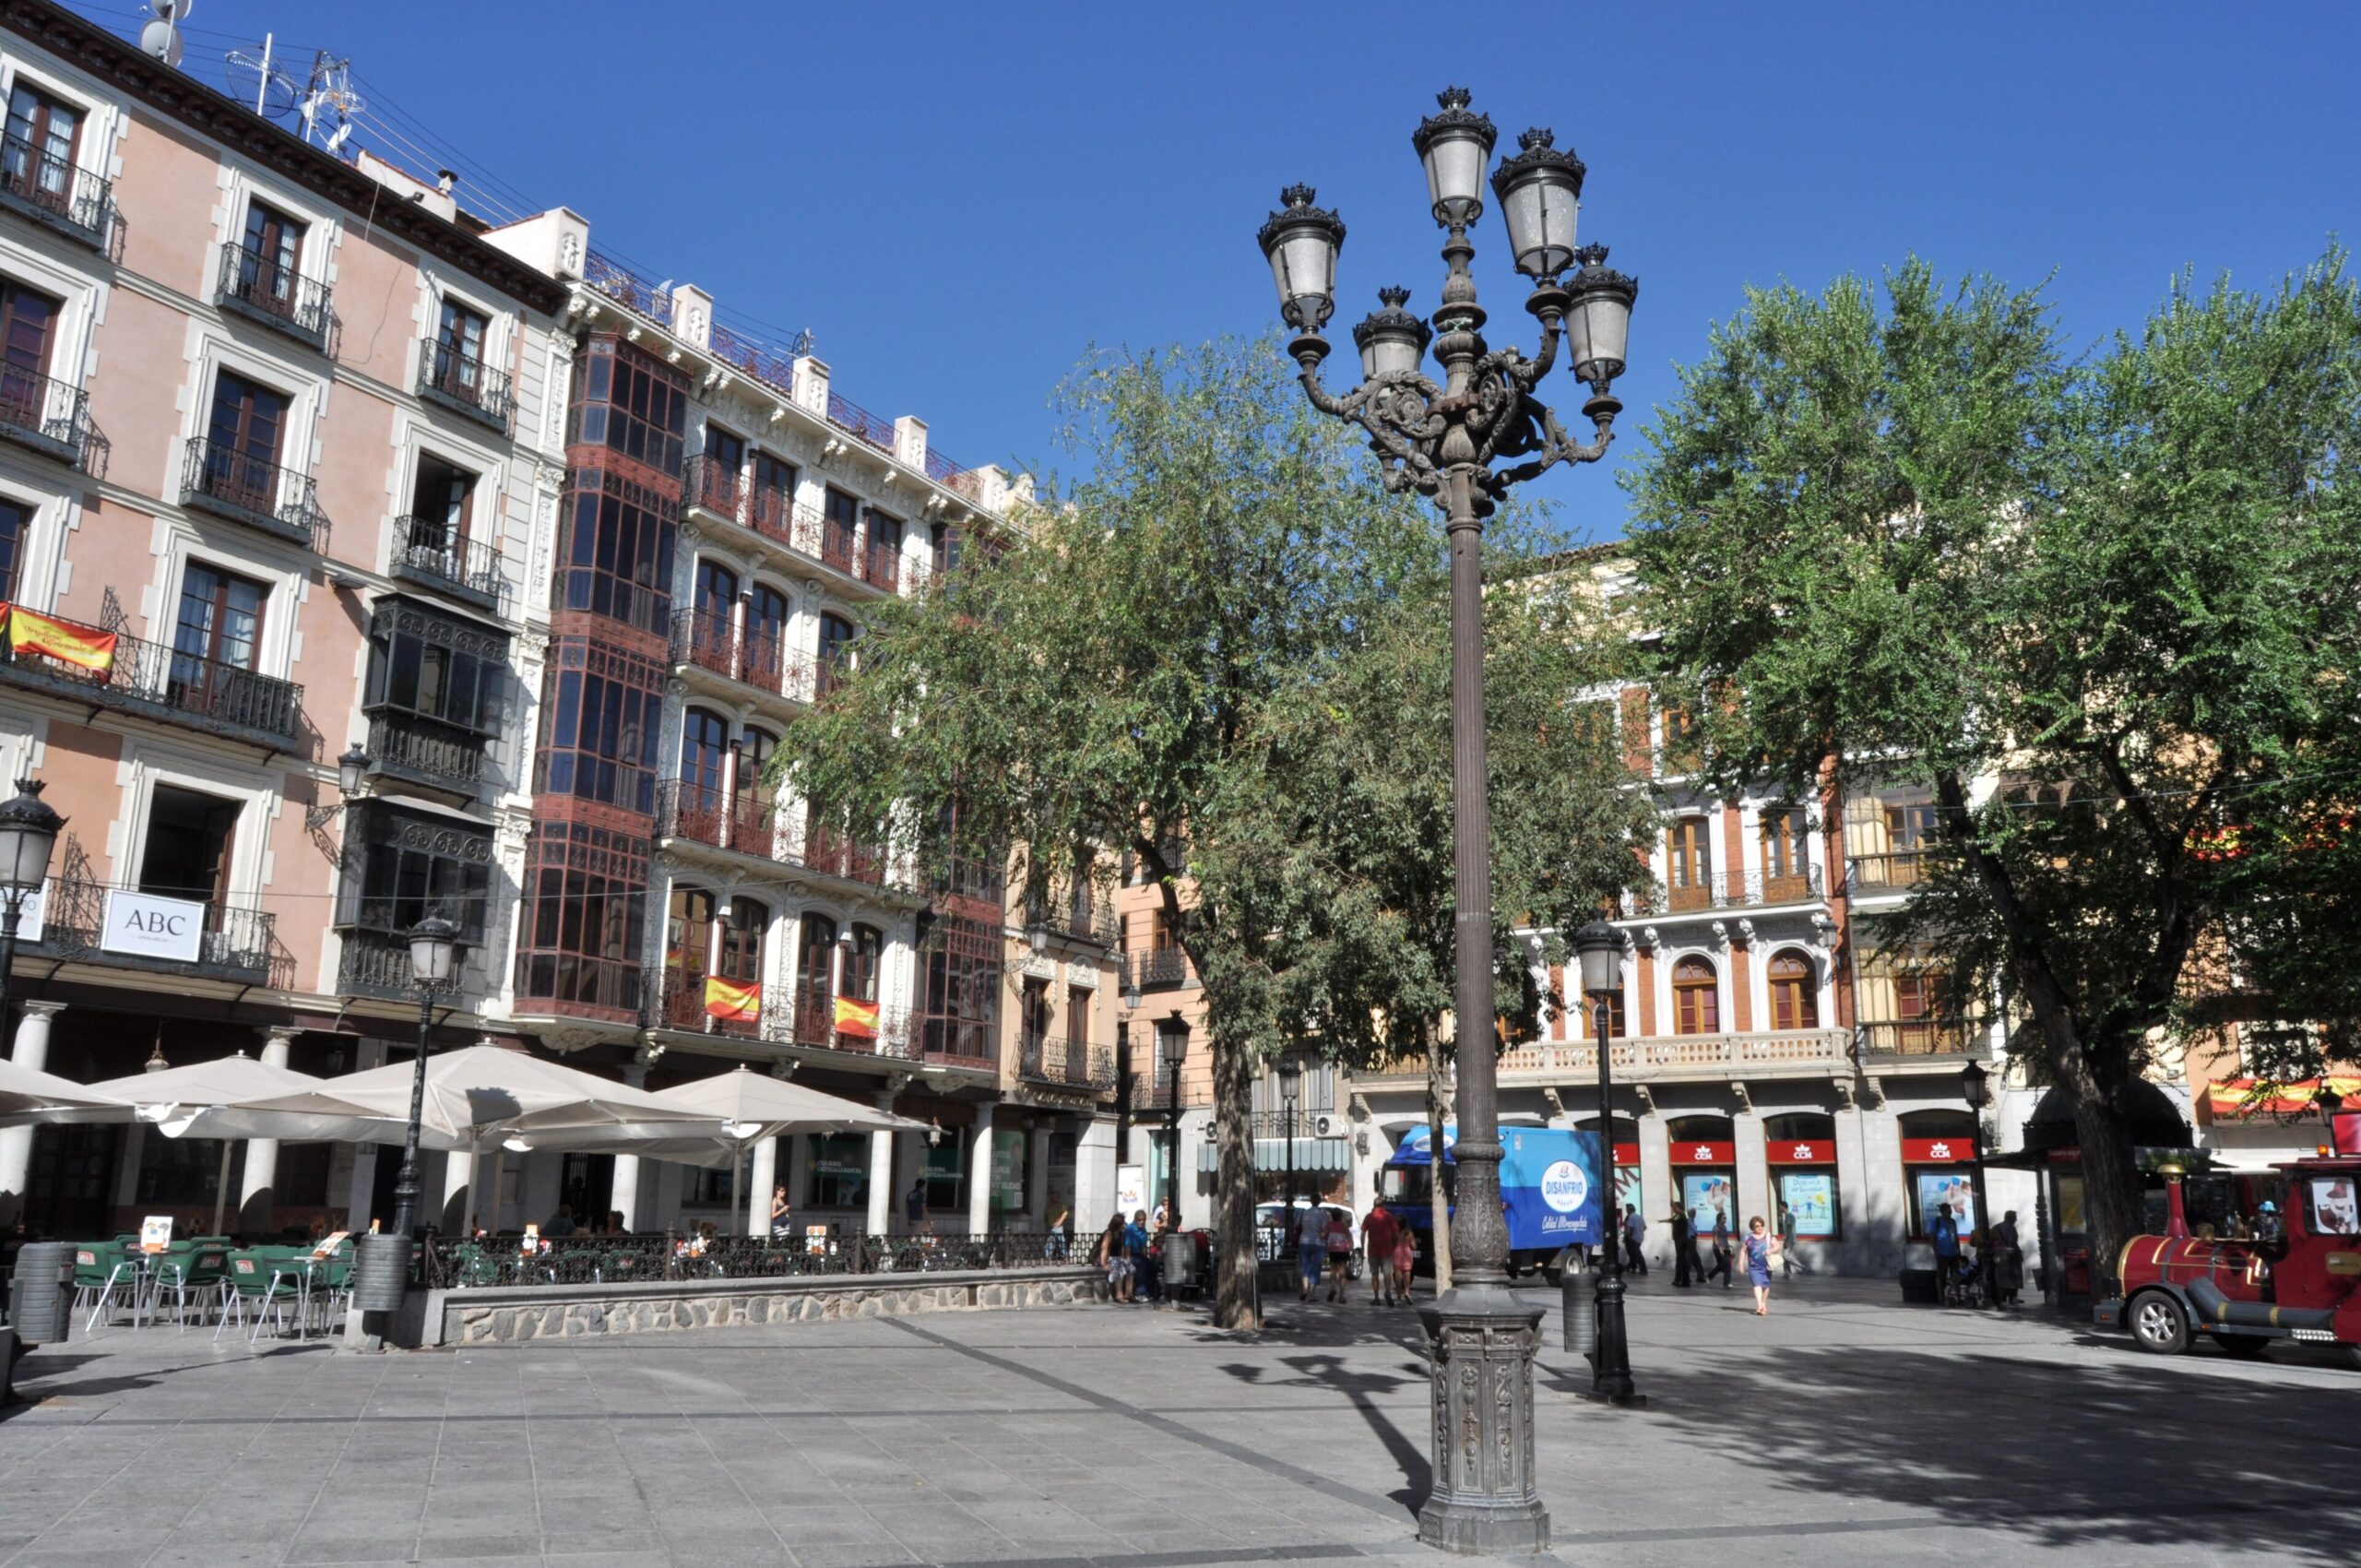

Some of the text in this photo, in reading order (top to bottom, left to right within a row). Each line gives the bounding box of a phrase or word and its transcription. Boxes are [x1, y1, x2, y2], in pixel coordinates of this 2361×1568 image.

[125, 909, 186, 936] ABC
[1695, 1152, 1713, 1160] CCM
[1793, 1151, 1812, 1159] CCM
[1930, 1150, 1951, 1158] CCM
[1546, 1181, 1584, 1195] DISANFRIO
